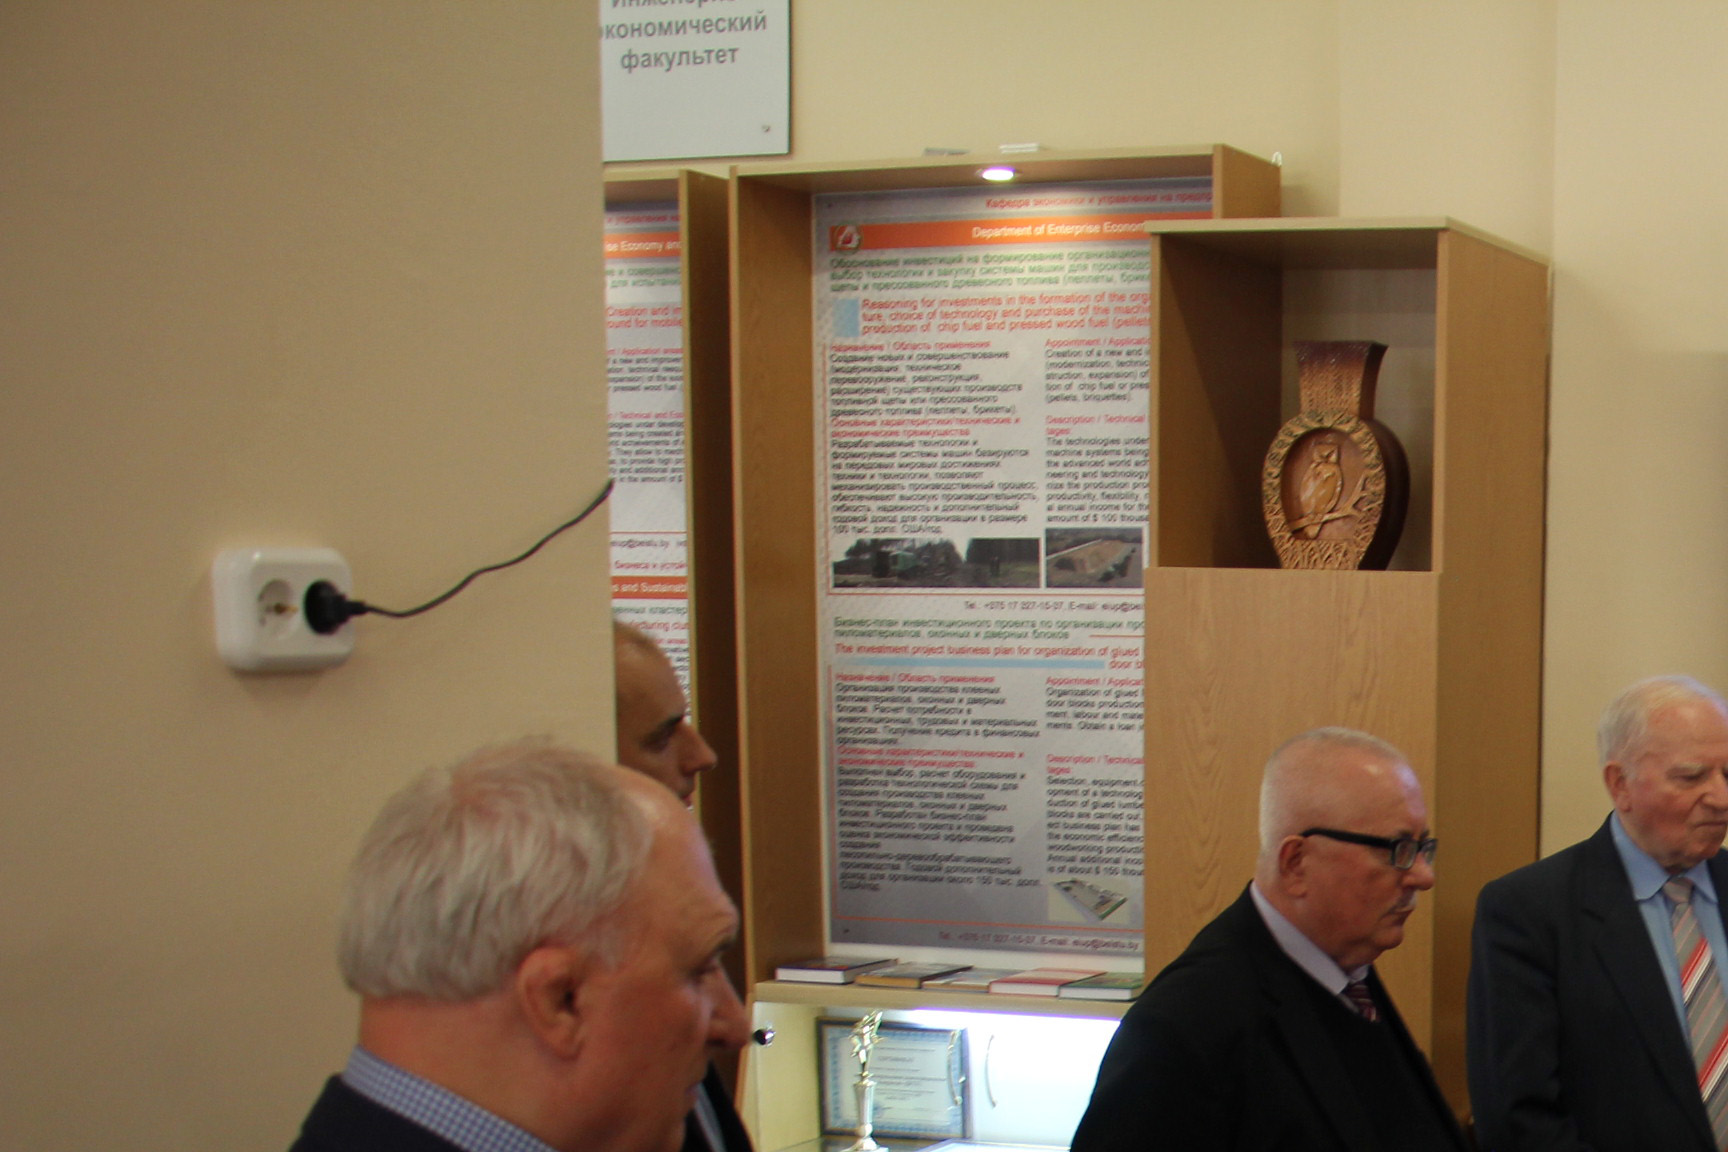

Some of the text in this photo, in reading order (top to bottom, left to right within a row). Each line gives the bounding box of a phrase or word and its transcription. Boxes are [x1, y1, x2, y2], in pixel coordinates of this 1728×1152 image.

[600, 9, 767, 39] кономический
[620, 48, 739, 74] факультет
[973, 220, 1147, 240] Department of Enterprise Econom
[861, 297, 918, 313] Reasoning
[920, 297, 935, 309] for
[937, 295, 1002, 308] investments
[1019, 294, 1035, 306] the
[1039, 292, 1091, 305] formation
[1107, 291, 1126, 303] the
[1129, 293, 1149, 305] org
[861, 311, 883, 324] ture,
[888, 310, 923, 321] choice
[939, 307, 997, 322] technology
[1001, 307, 1021, 318] and
[1025, 305, 1074, 320] purchase
[1092, 304, 1110, 316] the
[1113, 303, 1149, 315] machi
[861, 322, 917, 336] production
[937, 321, 959, 334] chip
[962, 320, 982, 331] fuel
[985, 320, 1005, 331] and
[1009, 318, 1052, 332] pressed
[1056, 317, 1085, 329] wood
[1088, 317, 1109, 328] fuel
[835, 644, 853, 653] The
[856, 644, 908, 654] investment
[911, 644, 944, 656] project
[947, 645, 990, 655] business
[993, 645, 1014, 657] plan
[1017, 646, 1030, 655] for
[1034, 646, 1094, 658] organization
[1111, 647, 1138, 658] glued
